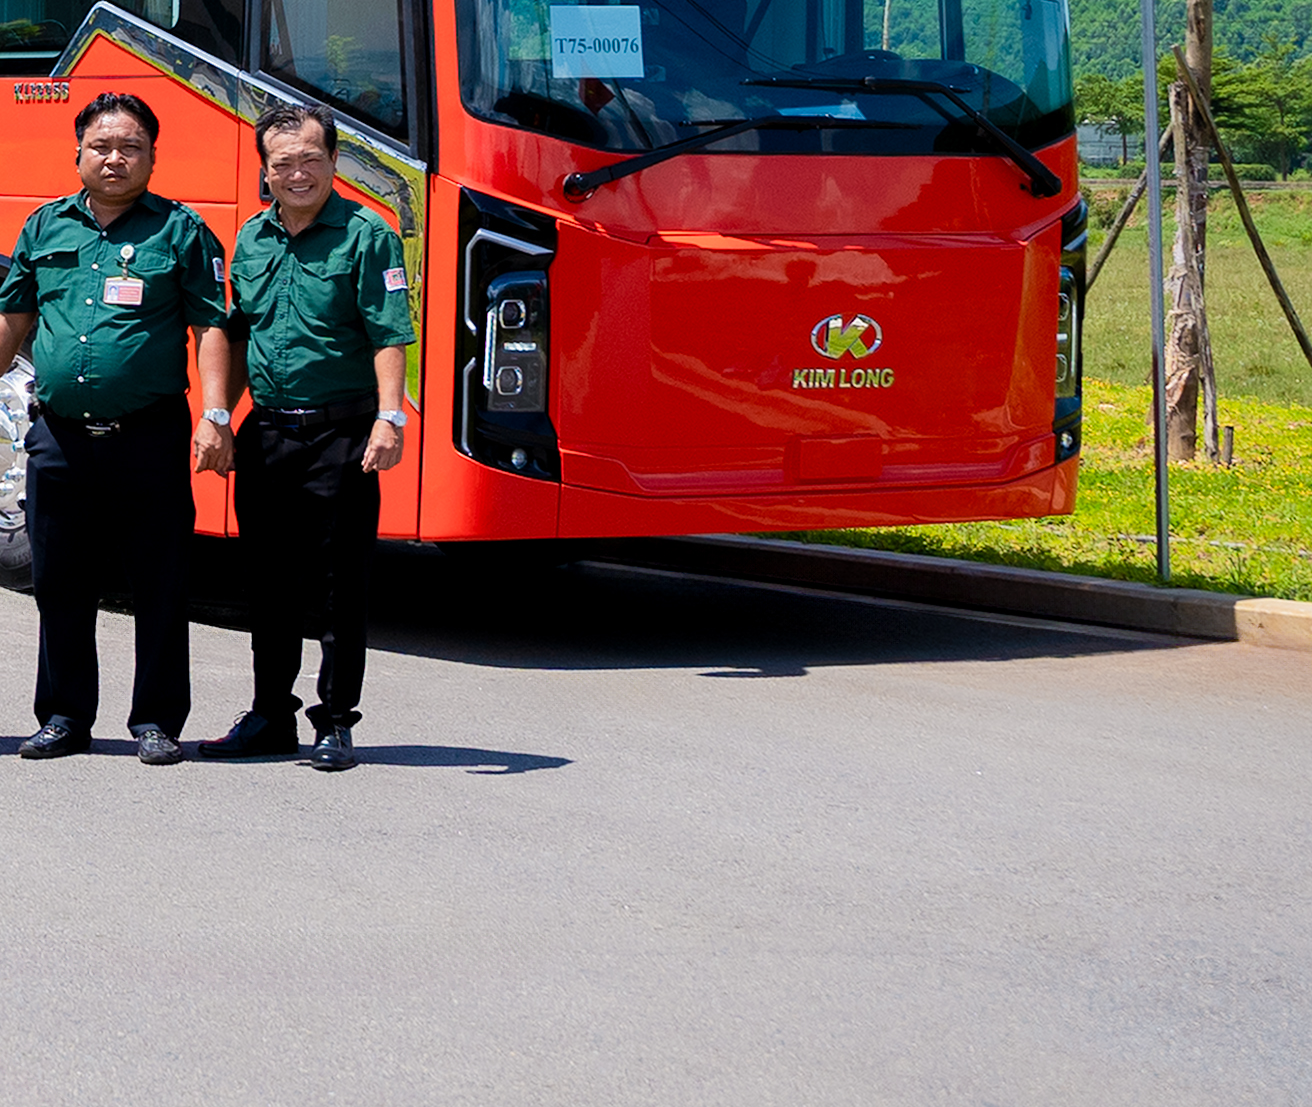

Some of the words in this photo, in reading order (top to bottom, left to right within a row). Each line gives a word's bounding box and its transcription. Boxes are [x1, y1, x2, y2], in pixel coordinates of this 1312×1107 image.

[555, 37, 640, 54] T75-00076
[792, 368, 836, 388] KIM
[838, 368, 895, 388] LONG
